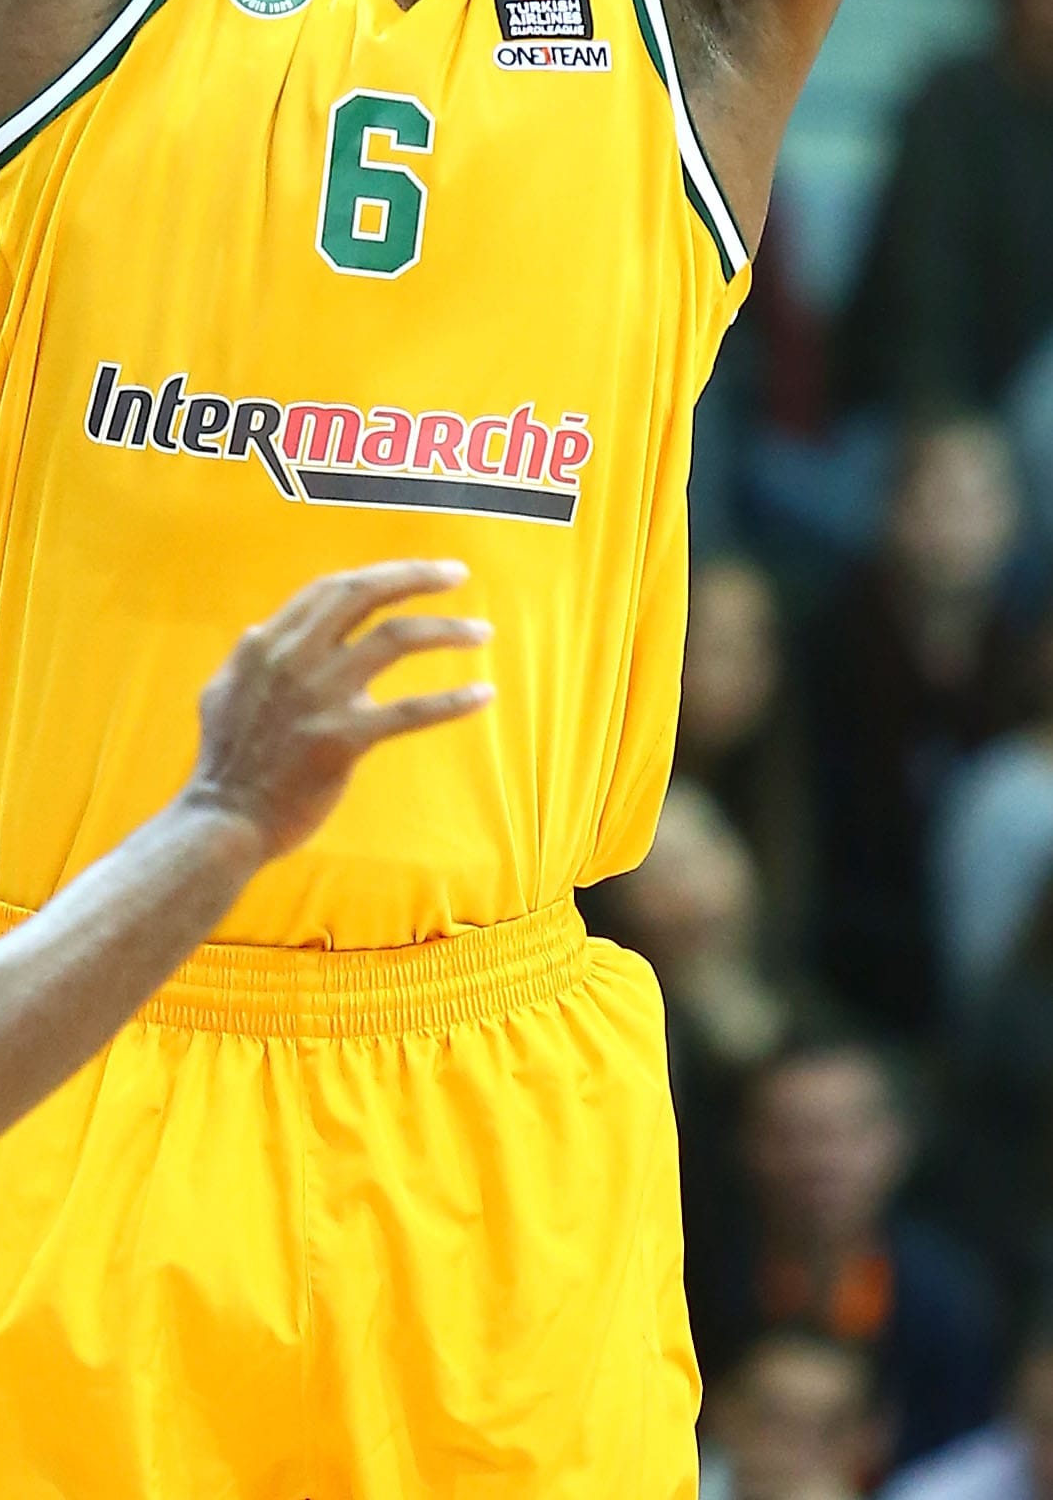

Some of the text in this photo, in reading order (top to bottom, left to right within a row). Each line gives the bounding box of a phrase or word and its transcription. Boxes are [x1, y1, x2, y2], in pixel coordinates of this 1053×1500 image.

[506, 0, 581, 14] TURKISH
[509, 12, 583, 26] AIRLINES
[315, 88, 436, 280] 6
